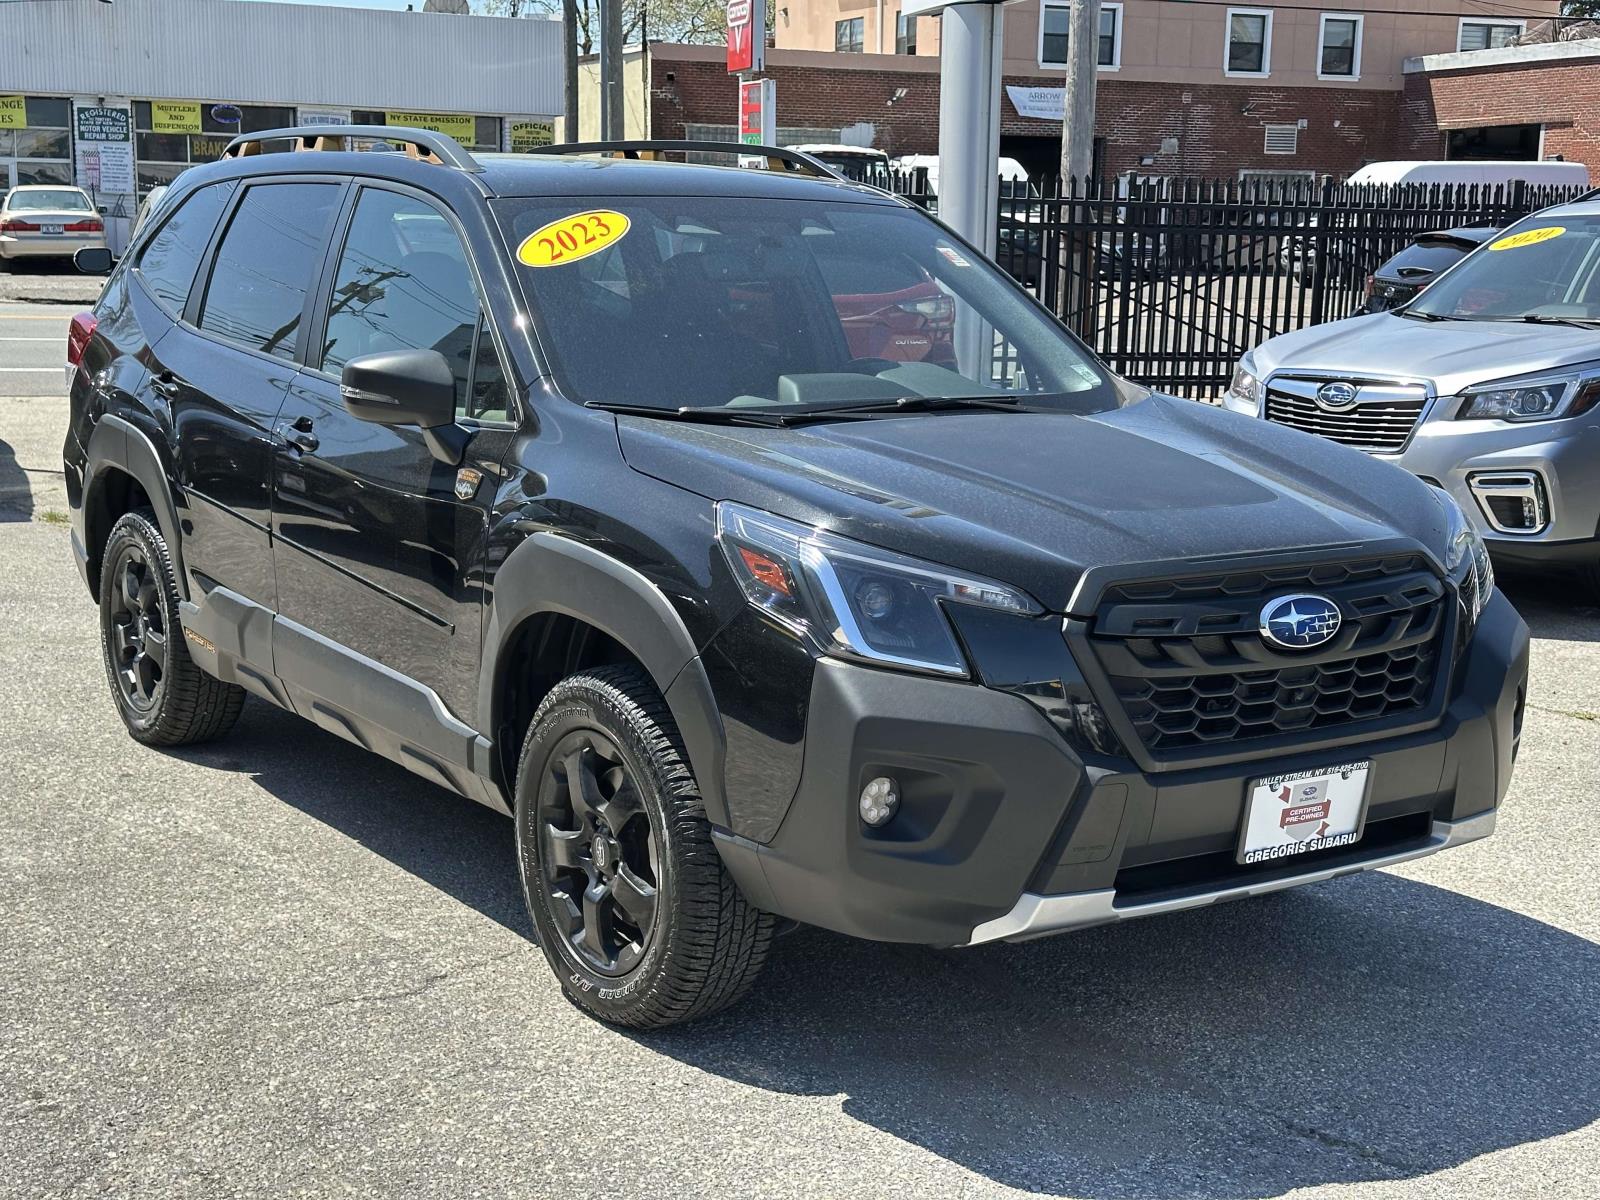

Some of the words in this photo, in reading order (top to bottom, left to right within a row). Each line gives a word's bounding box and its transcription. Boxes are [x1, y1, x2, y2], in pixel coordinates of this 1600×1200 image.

[1028, 91, 1061, 100] ARROW
[0, 100, 24, 109] NGE
[156, 104, 196, 113] MUFFLERS
[80, 108, 127, 122] REGISTERED
[403, 115, 428, 123] STATE
[430, 116, 471, 125] EMISSION
[154, 122, 200, 131] SUSPENSION
[512, 122, 553, 133] OFFICIAL
[84, 132, 107, 140] REPAIR
[538, 215, 611, 261] 2023
[1259, 775, 1284, 787] VALLEY
[1314, 768, 1325, 777] NY
[1289, 805, 1323, 816] CERTIFIED
[1285, 811, 1325, 823] PRE-OWNED
[1245, 841, 1307, 864] GREGORIS
[1309, 833, 1357, 851] SUBARU
